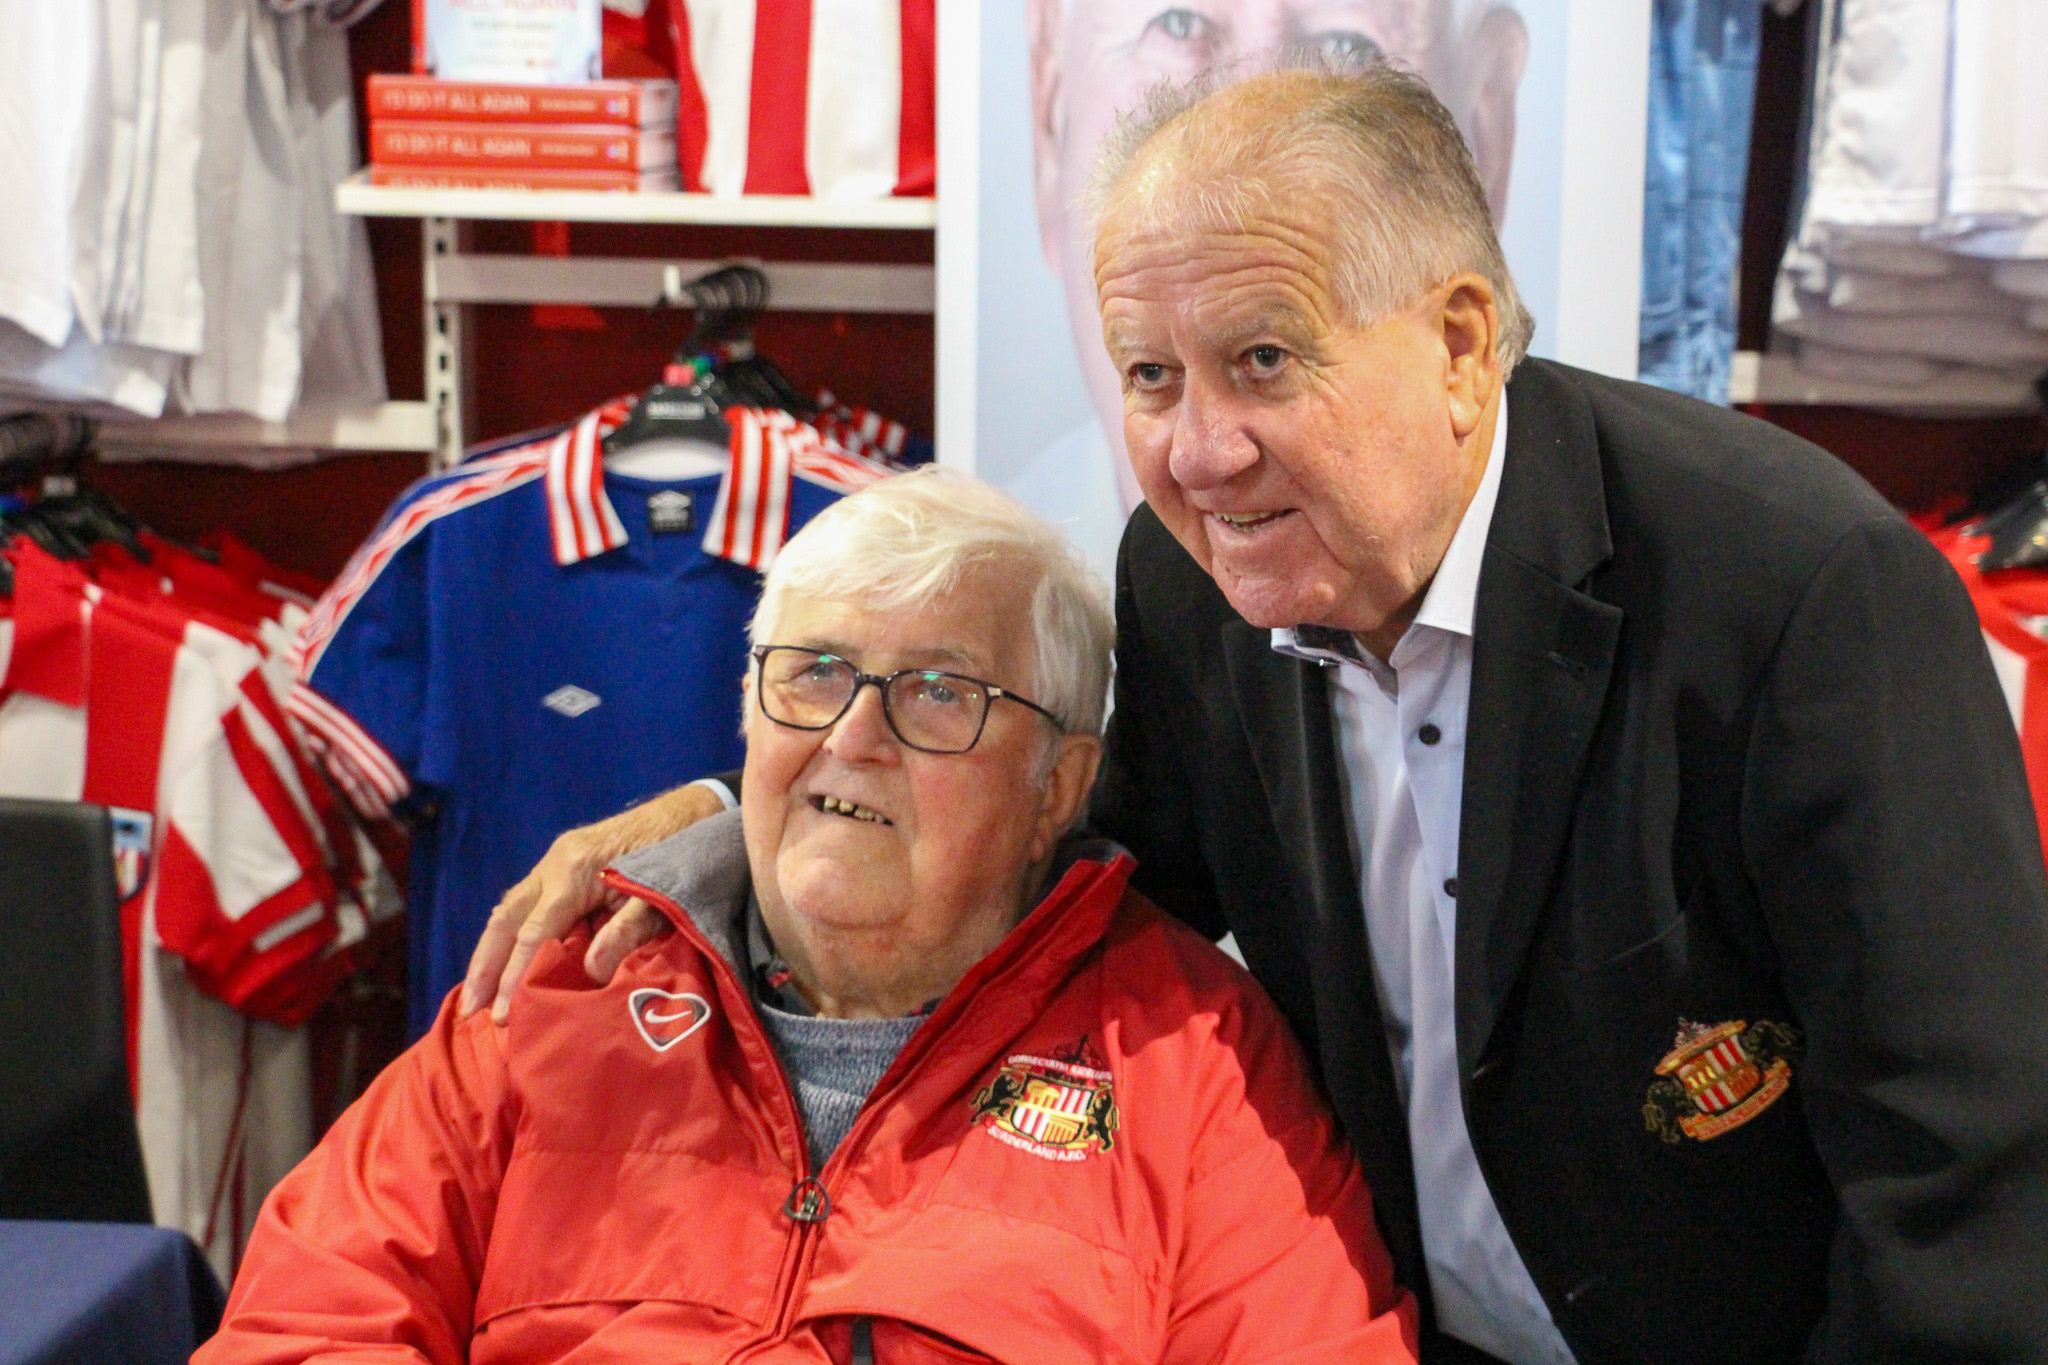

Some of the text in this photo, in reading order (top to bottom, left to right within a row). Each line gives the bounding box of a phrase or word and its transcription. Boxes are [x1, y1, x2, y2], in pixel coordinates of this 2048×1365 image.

[451, 92, 476, 113] ALL
[482, 93, 531, 114] AGAIN
[453, 136, 478, 157] ALL
[483, 137, 531, 158] AGAIN
[987, 1125, 1057, 1160] SUNDERLAND
